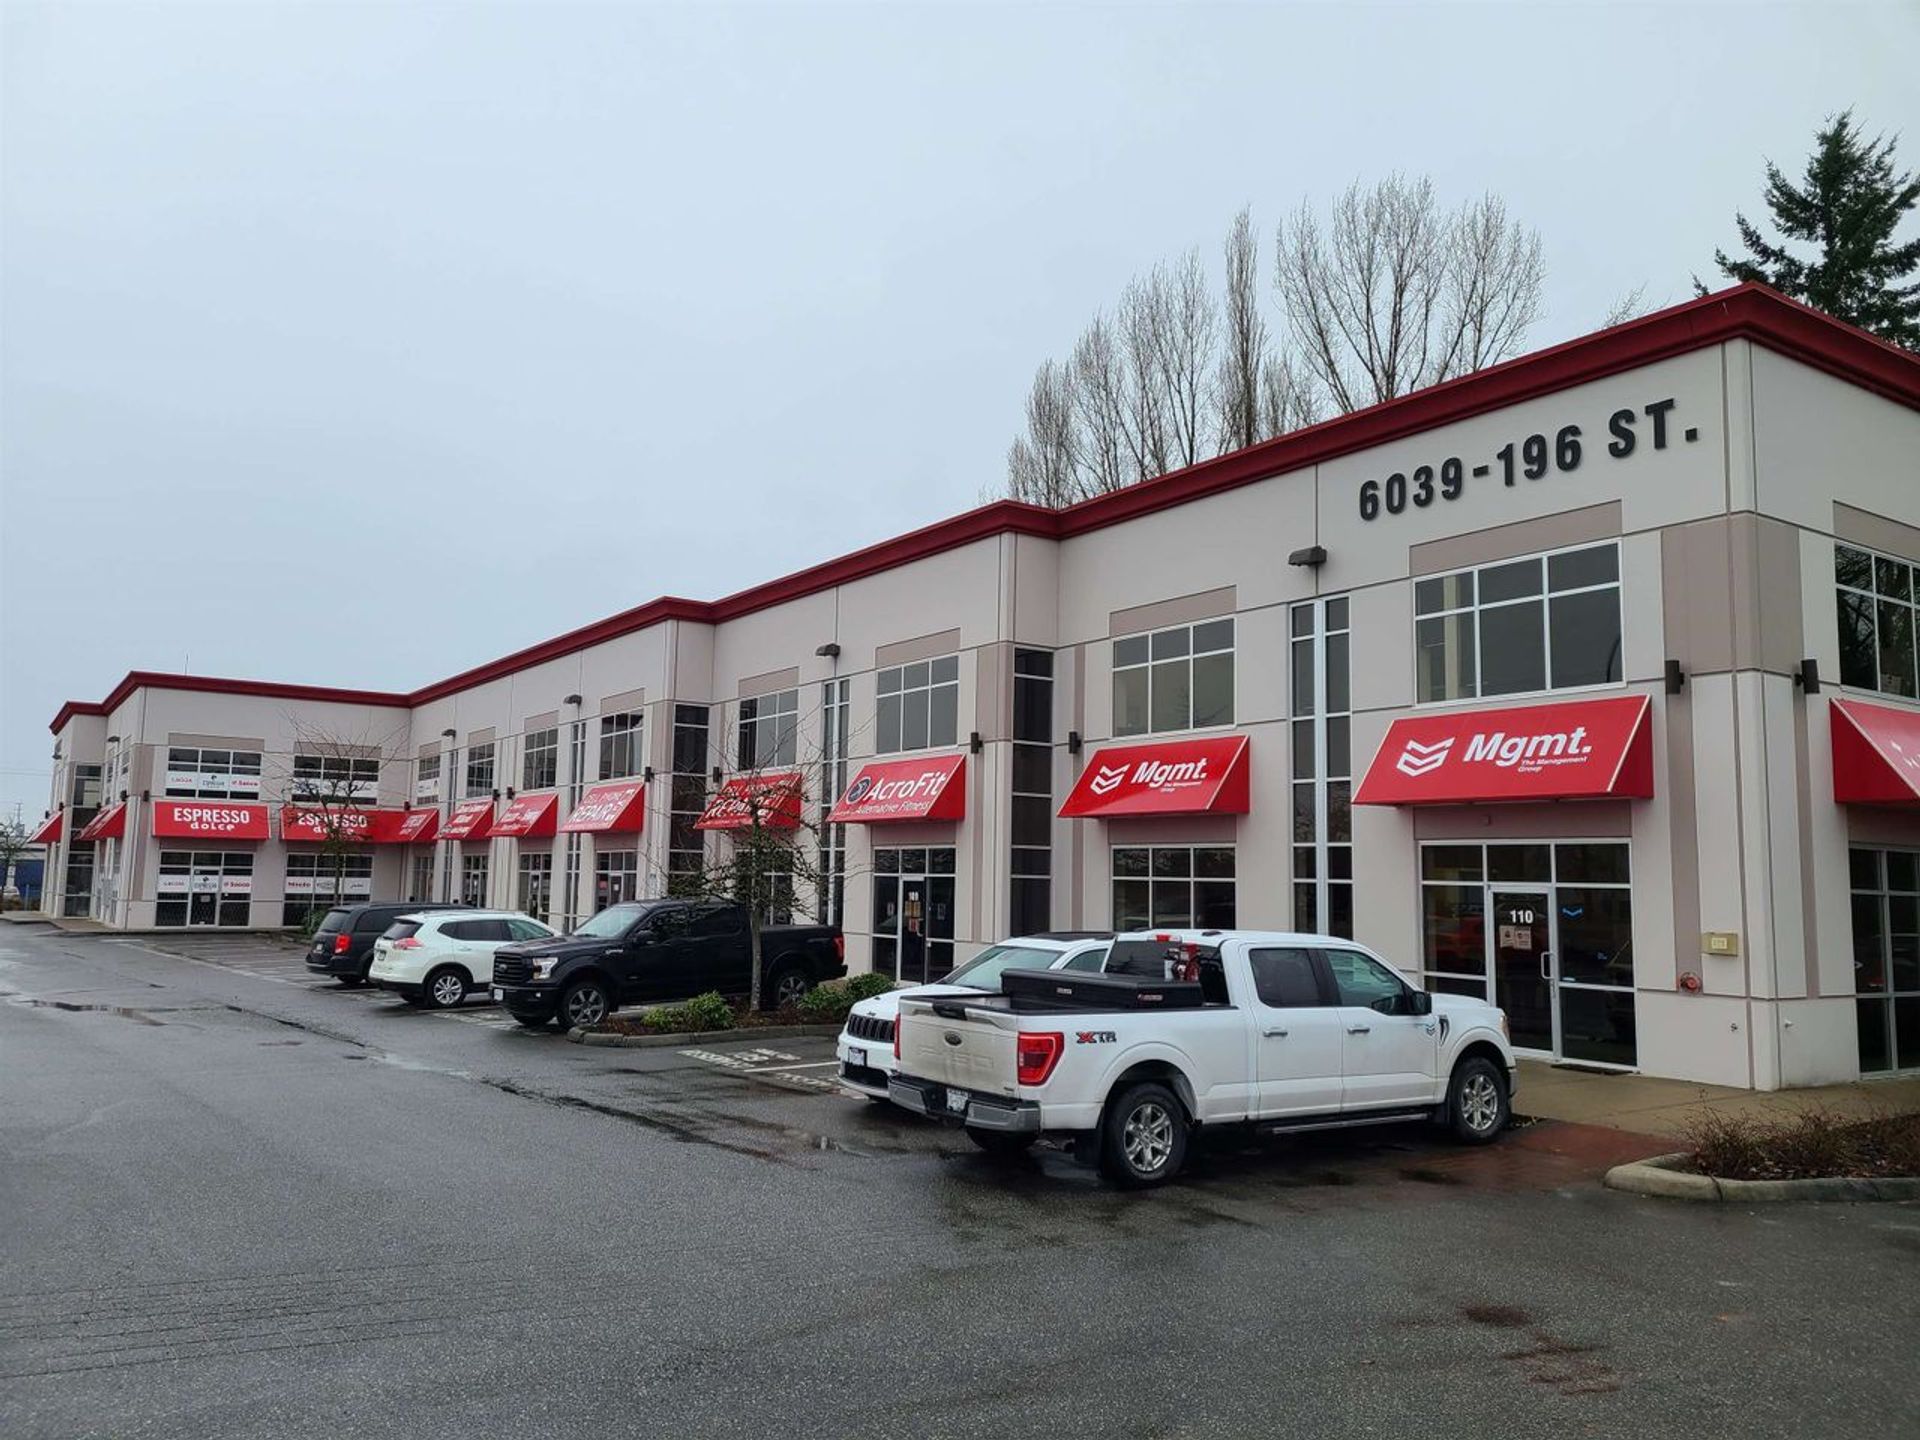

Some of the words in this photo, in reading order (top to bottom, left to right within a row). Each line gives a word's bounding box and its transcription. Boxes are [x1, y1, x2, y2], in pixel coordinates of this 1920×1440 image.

[1359, 424, 1582, 521] 6039-196
[1608, 398, 1698, 458] ST.
[1463, 727, 1592, 767] Mgmt.
[862, 771, 947, 801] AcroFit
[1131, 757, 1207, 788] Mgmt.
[173, 807, 250, 824] ESPRESSO
[1510, 909, 1534, 924] 110
